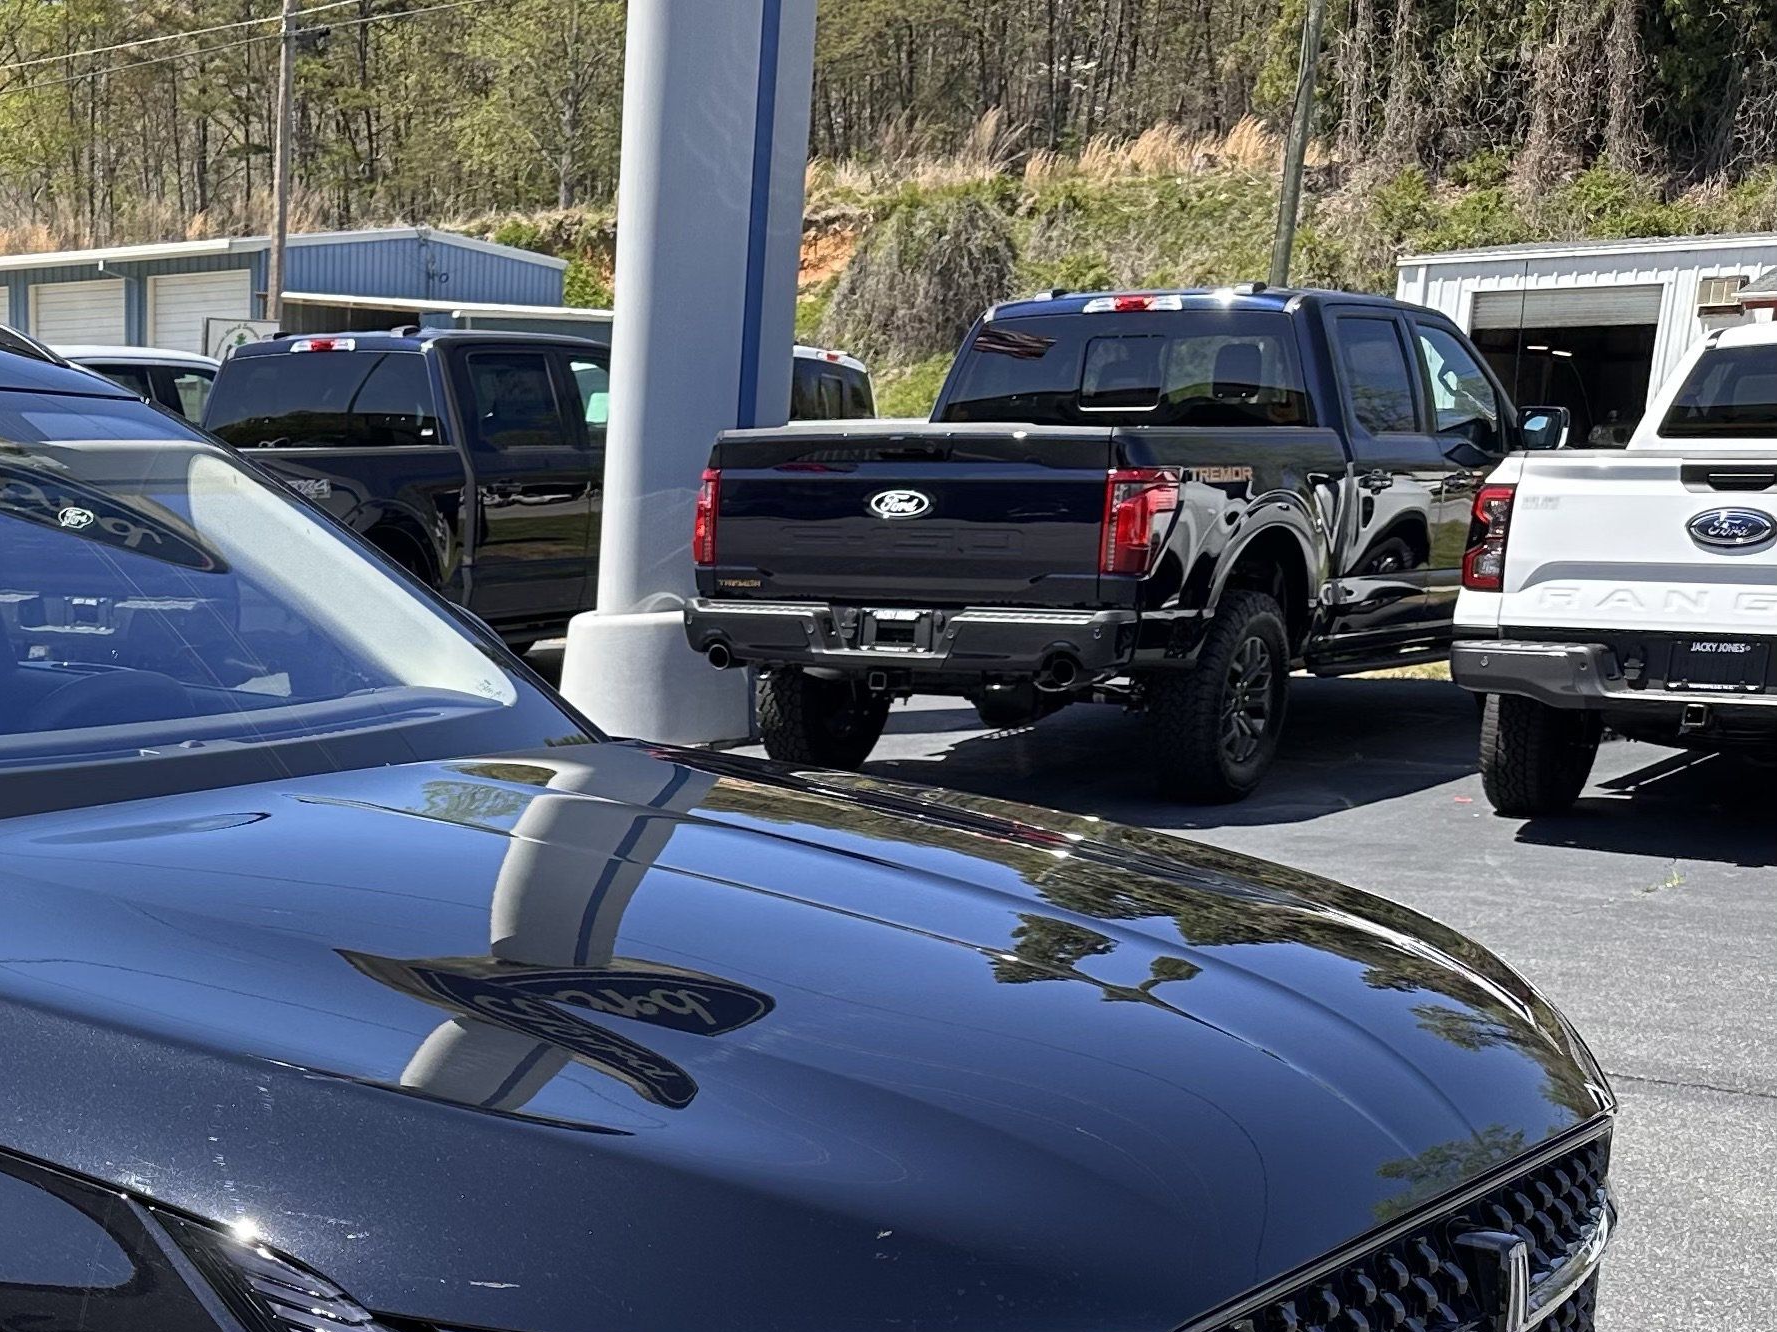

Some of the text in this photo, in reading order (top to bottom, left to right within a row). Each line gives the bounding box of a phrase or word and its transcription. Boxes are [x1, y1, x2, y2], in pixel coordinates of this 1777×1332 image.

[1188, 466, 1253, 483] TREMOR
[1690, 641, 1746, 653] JACKY JONES
